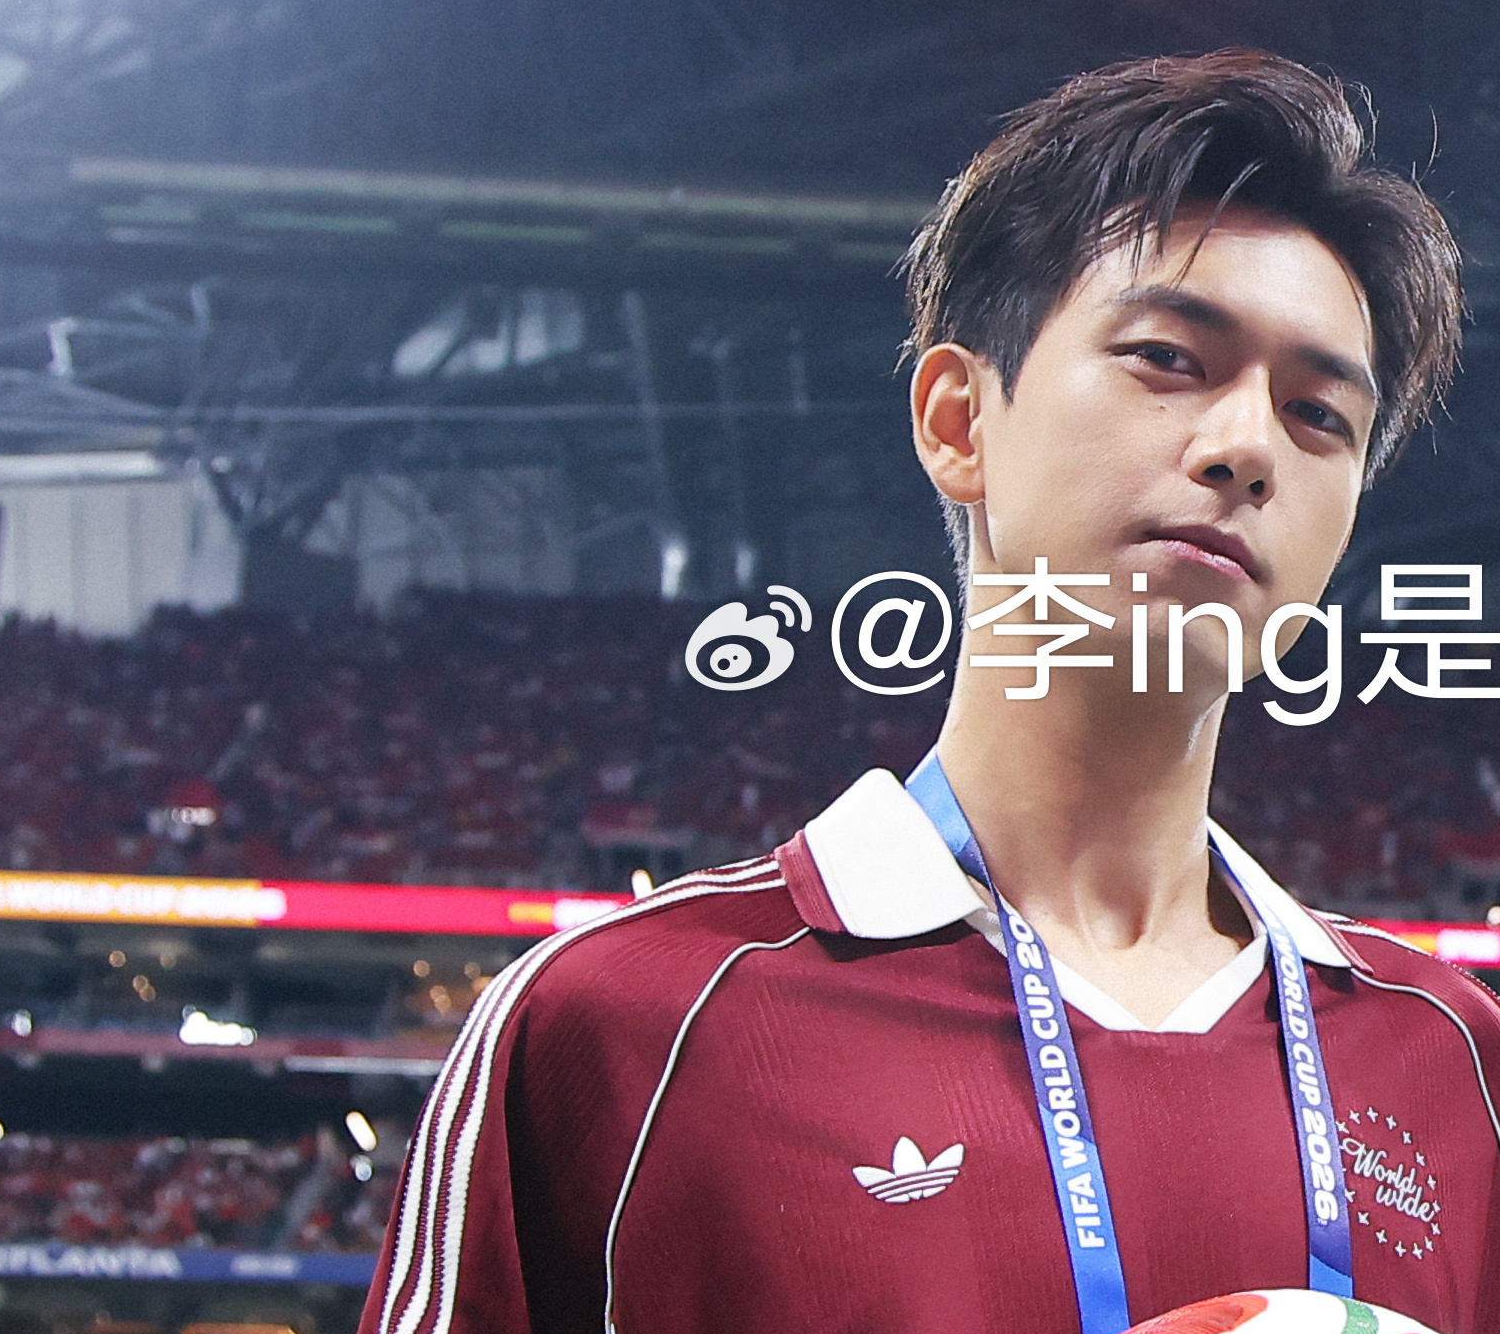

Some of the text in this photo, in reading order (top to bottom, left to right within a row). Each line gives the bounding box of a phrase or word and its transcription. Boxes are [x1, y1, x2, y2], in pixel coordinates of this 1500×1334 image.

[1023, 973, 1061, 1041] CUP
[1039, 1043, 1088, 1169] WORLD
[1276, 925, 1340, 1221] WORLD CUP 2026
[1341, 1137, 1417, 1194] World
[1067, 1172, 1105, 1248] FIFA
[1376, 1185, 1435, 1222] wide
